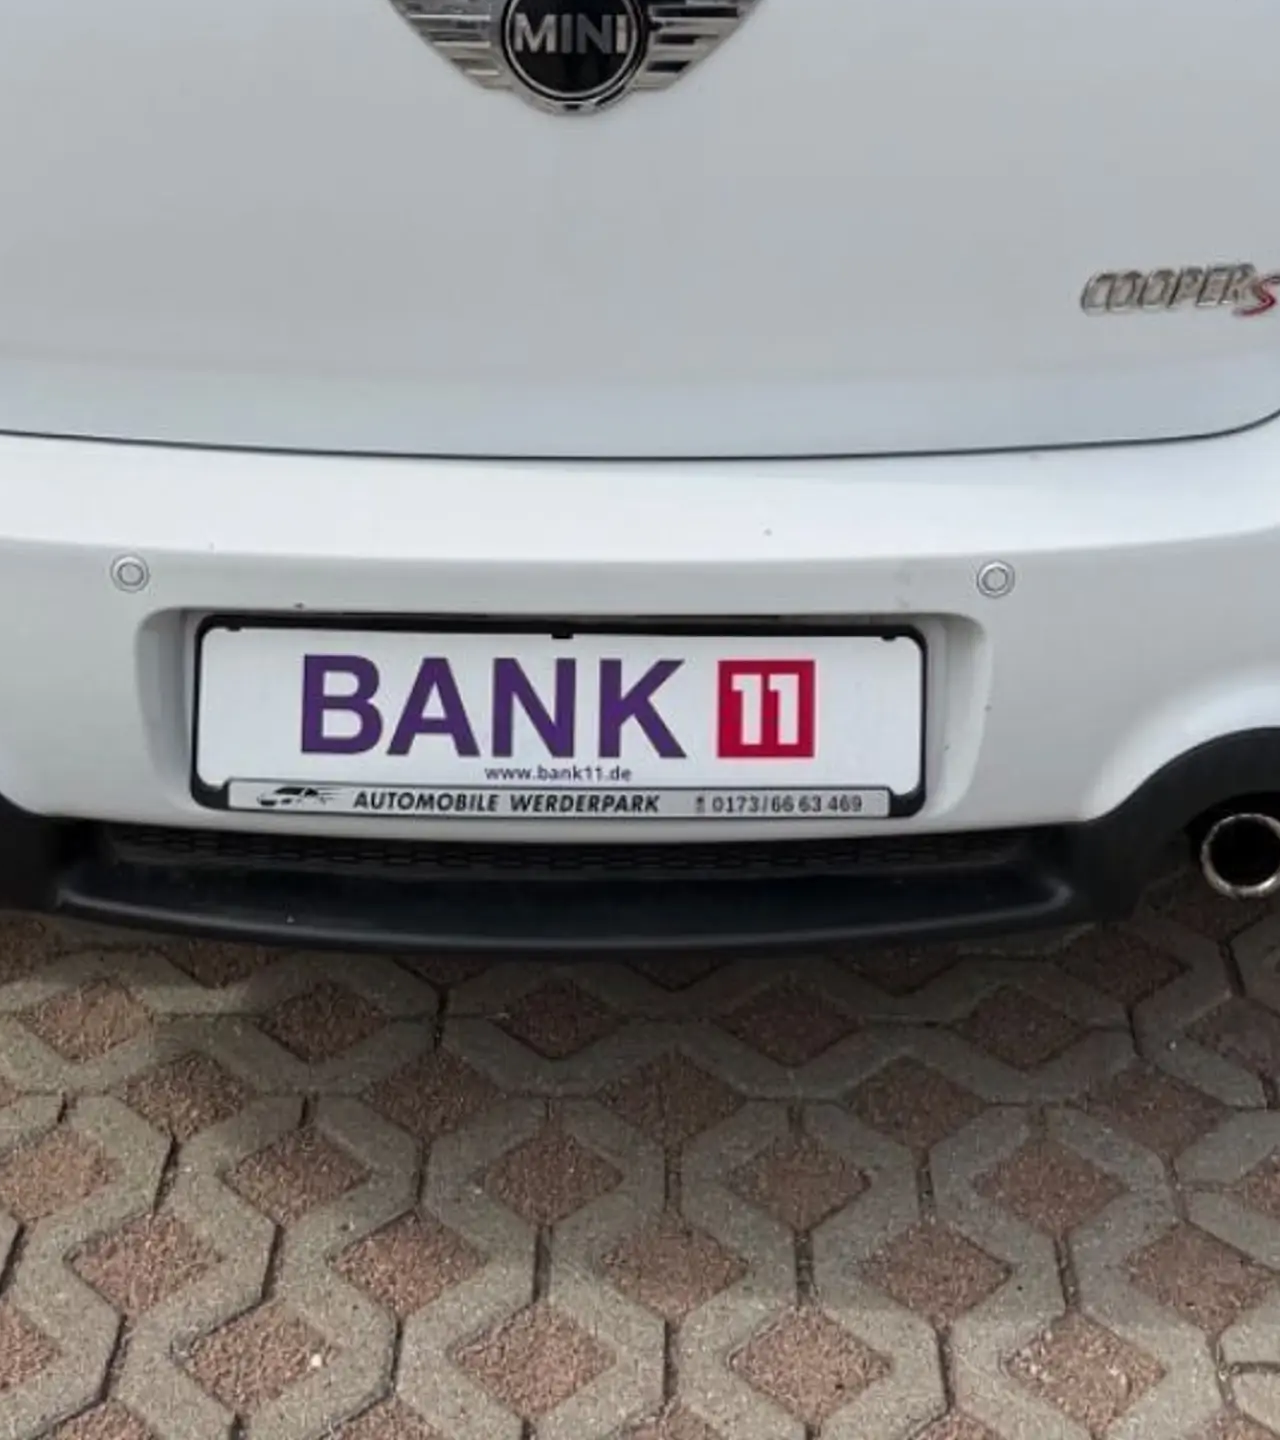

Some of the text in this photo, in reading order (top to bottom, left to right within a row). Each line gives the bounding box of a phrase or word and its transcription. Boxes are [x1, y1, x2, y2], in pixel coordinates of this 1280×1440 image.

[513, 13, 628, 54] MINI
[1081, 263, 1257, 316] COOPER
[301, 654, 800, 759] BANK 11
[485, 765, 632, 783] www.bank11.de
[352, 791, 499, 811] AUTOMOBILE
[509, 792, 661, 814] WERDERPARK
